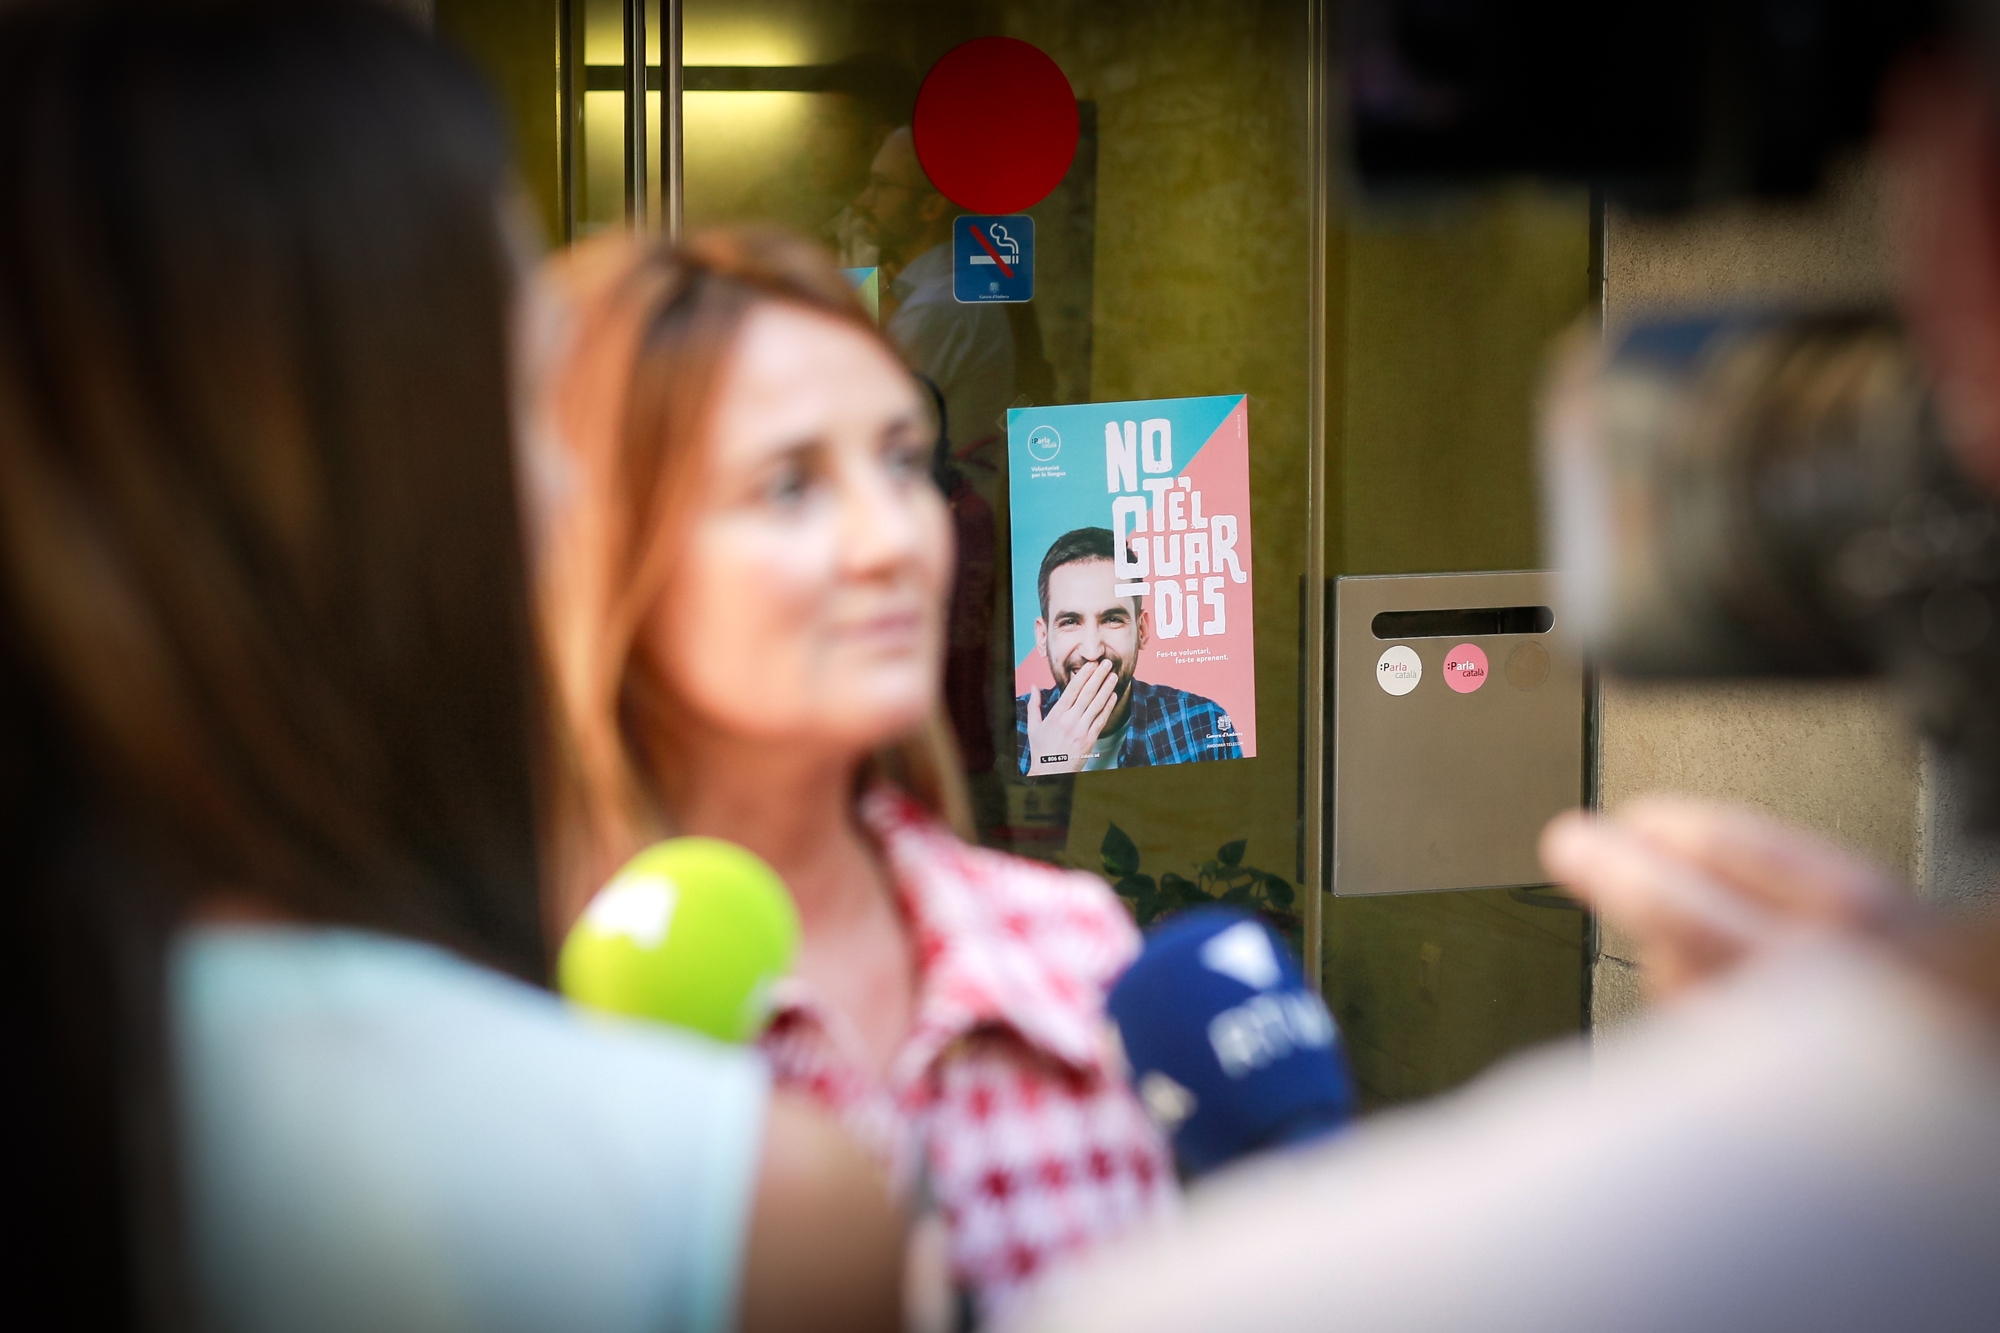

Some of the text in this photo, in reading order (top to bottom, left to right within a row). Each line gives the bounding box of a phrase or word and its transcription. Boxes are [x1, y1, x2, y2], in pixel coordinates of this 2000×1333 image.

[1105, 418, 1173, 494] NO
[1156, 647, 1211, 658] Fes-te voluntari,
[1175, 654, 1229, 664] fes-te aprenent.
[1380, 662, 1408, 672] :Parla
[1447, 660, 1475, 671] :Parla
[1394, 670, 1417, 679] català
[1462, 668, 1484, 678] català
